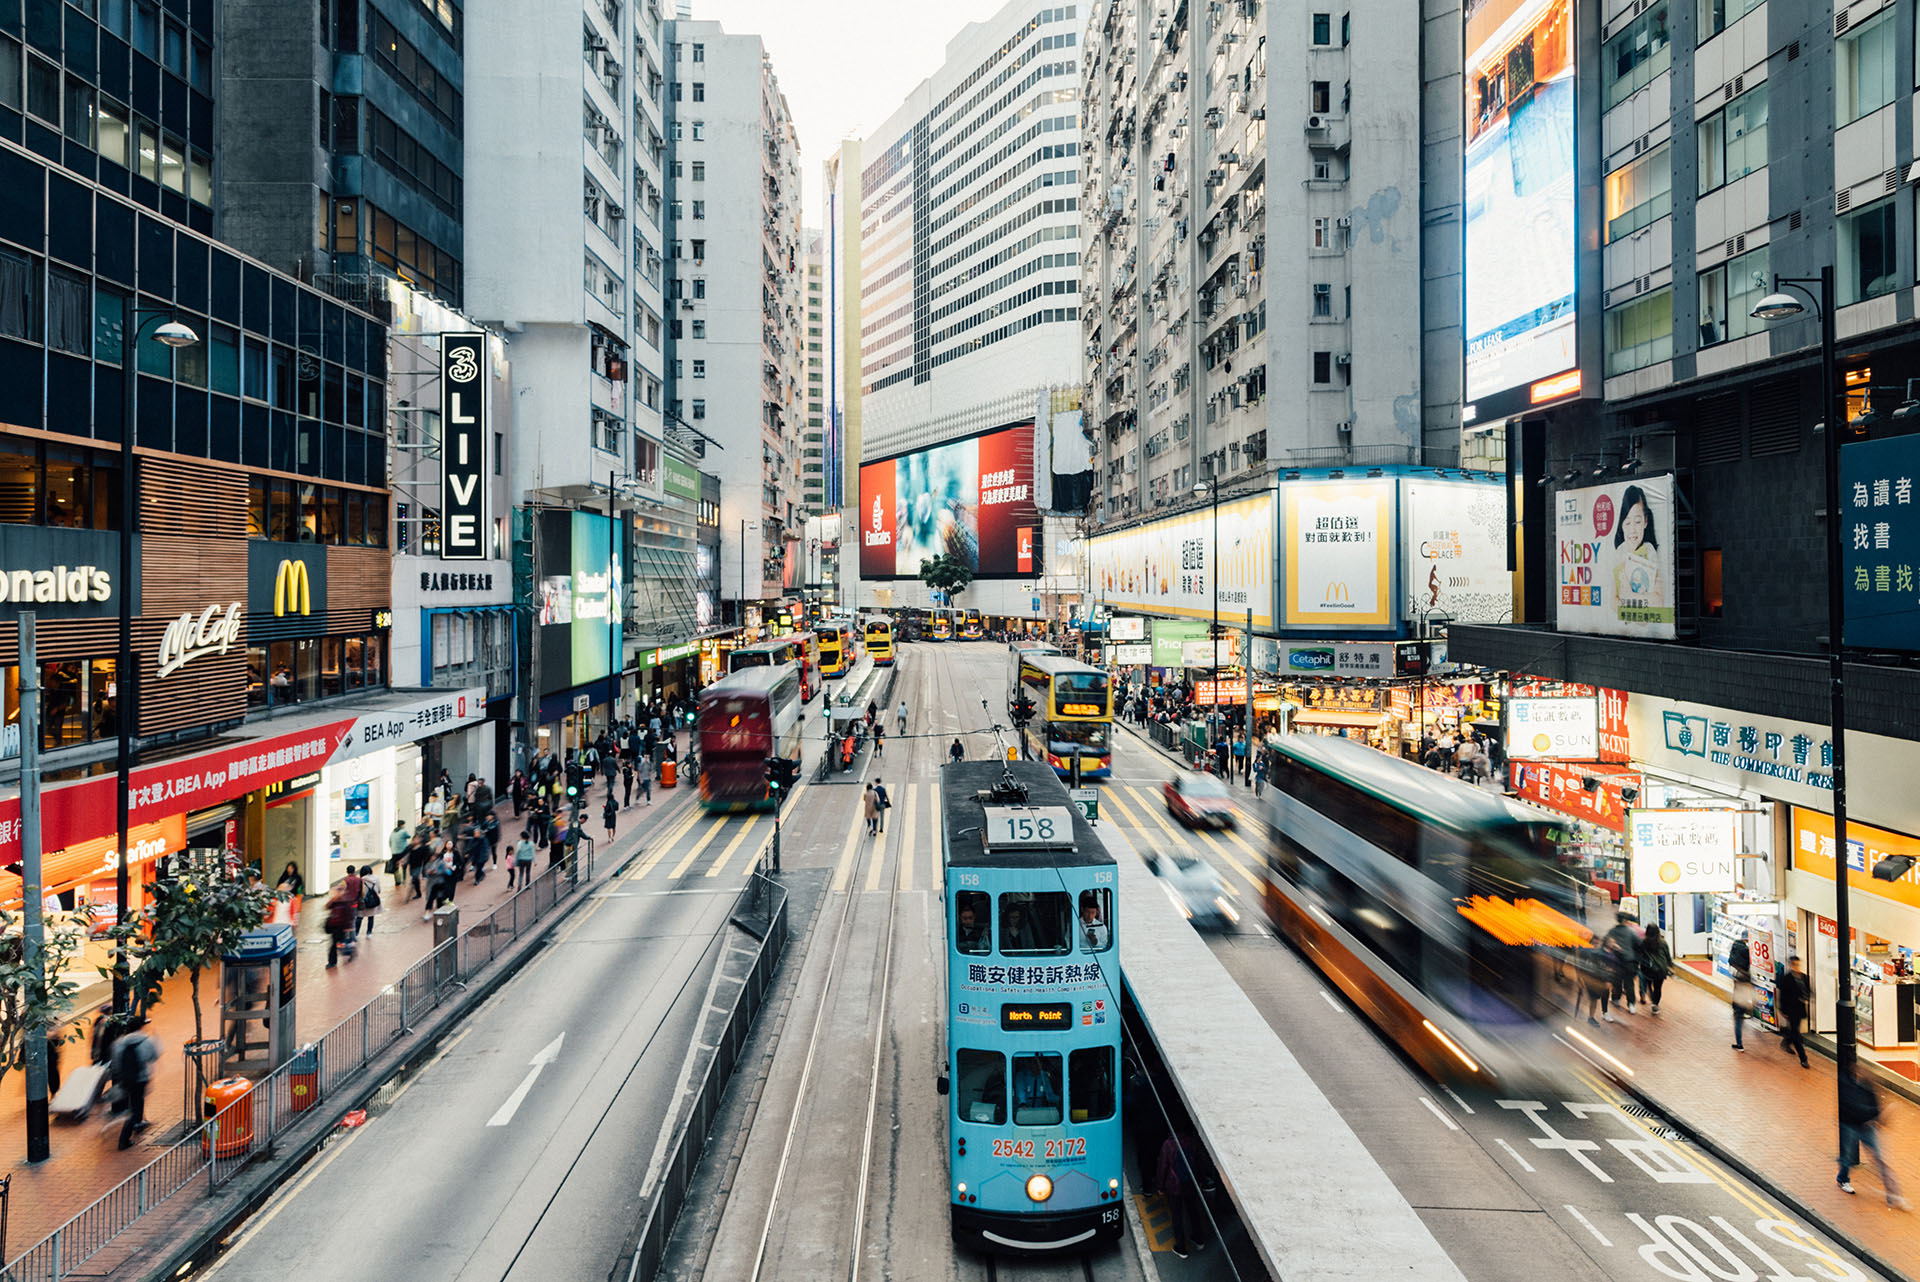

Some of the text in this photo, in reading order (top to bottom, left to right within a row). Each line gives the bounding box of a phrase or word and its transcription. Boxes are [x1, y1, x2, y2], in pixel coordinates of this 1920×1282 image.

[1469, 338, 1483, 354] FOR
[1483, 330, 1503, 349] LEASE
[449, 392, 479, 547] LIVE
[1853, 476, 1912, 507] 為讀者
[1315, 516, 1359, 529] 超值選
[865, 530, 891, 547] Emirates
[1853, 522, 1891, 550] 找書
[1561, 567, 1593, 584] LAND
[1854, 564, 1920, 592] 為書找
[157, 602, 242, 673] McCafé
[1157, 638, 1181, 649] Pric
[1293, 654, 1331, 666] Cetaphil
[364, 721, 404, 743] BEA App
[1555, 734, 1591, 746] SUN
[1711, 750, 1834, 791] THE COMMERCIAL PRES
[203, 771, 226, 789] App
[1007, 818, 1055, 840] 158
[1094, 871, 1113, 883] 158
[1686, 861, 1730, 875] SUN
[960, 874, 980, 886] 158
[1753, 940, 1770, 960] 98
[969, 963, 1100, 985] 職安健投訴熱線
[960, 984, 998, 993] Occupational
[1000, 986, 1020, 994] Safety
[1009, 1010, 1033, 1021] North
[1039, 1010, 1062, 1020] Point
[993, 1137, 1086, 1158] 2542 2172
[1101, 1208, 1120, 1224] 158
